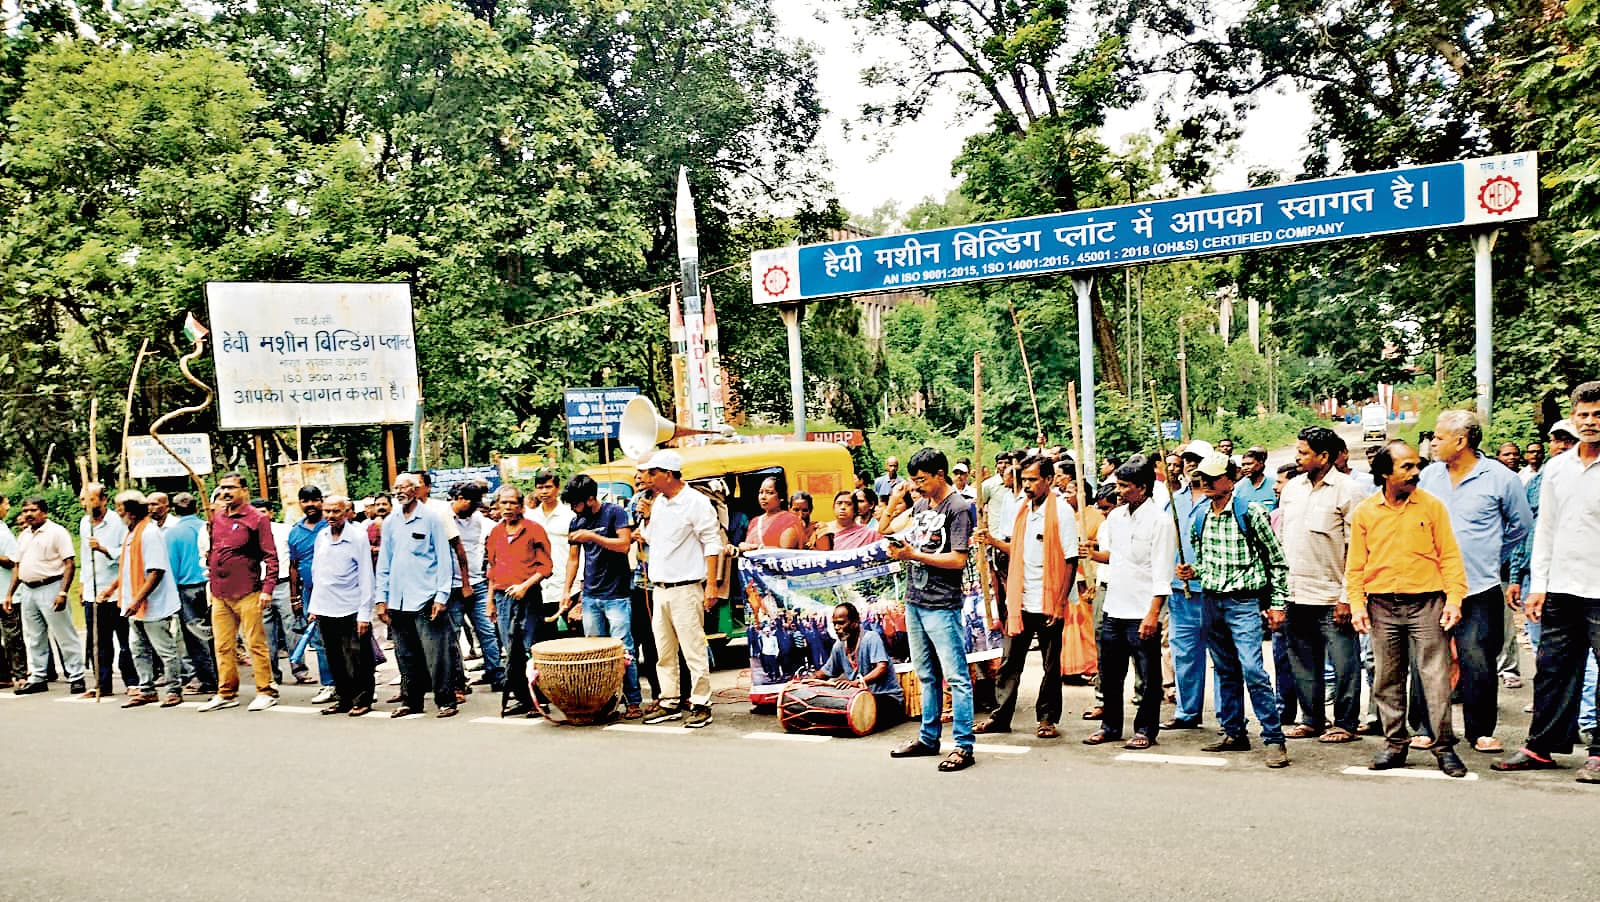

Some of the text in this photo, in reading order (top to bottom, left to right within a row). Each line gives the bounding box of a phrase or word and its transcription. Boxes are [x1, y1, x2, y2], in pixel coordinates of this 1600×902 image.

[823, 248, 862, 278] हैवी
[874, 239, 940, 270] मशीन
[952, 227, 1041, 262] बिल्डिंग
[1053, 217, 1117, 248] प्लांट
[1131, 207, 1153, 239] में
[1169, 202, 1263, 234] आपका
[1278, 188, 1375, 222] स्वागत
[883, 274, 900, 285] AN
[901, 271, 921, 284] ISO
[922, 266, 978, 282] 9001:2015,
[1121, 245, 1150, 259] 2018
[1152, 239, 1199, 256] (OH&S)
[1202, 230, 1273, 250] CERTIFIED
[1275, 222, 1345, 241] COMPANY
[259, 331, 308, 355] मशीन
[315, 329, 375, 352] बिल्डिंग
[691, 318, 708, 390] INDIA
[283, 373, 303, 384] ISO
[233, 387, 284, 404] आपका
[289, 387, 341, 404] स्वागत
[345, 386, 383, 402] करता
[146, 447, 191, 456] DIVION
